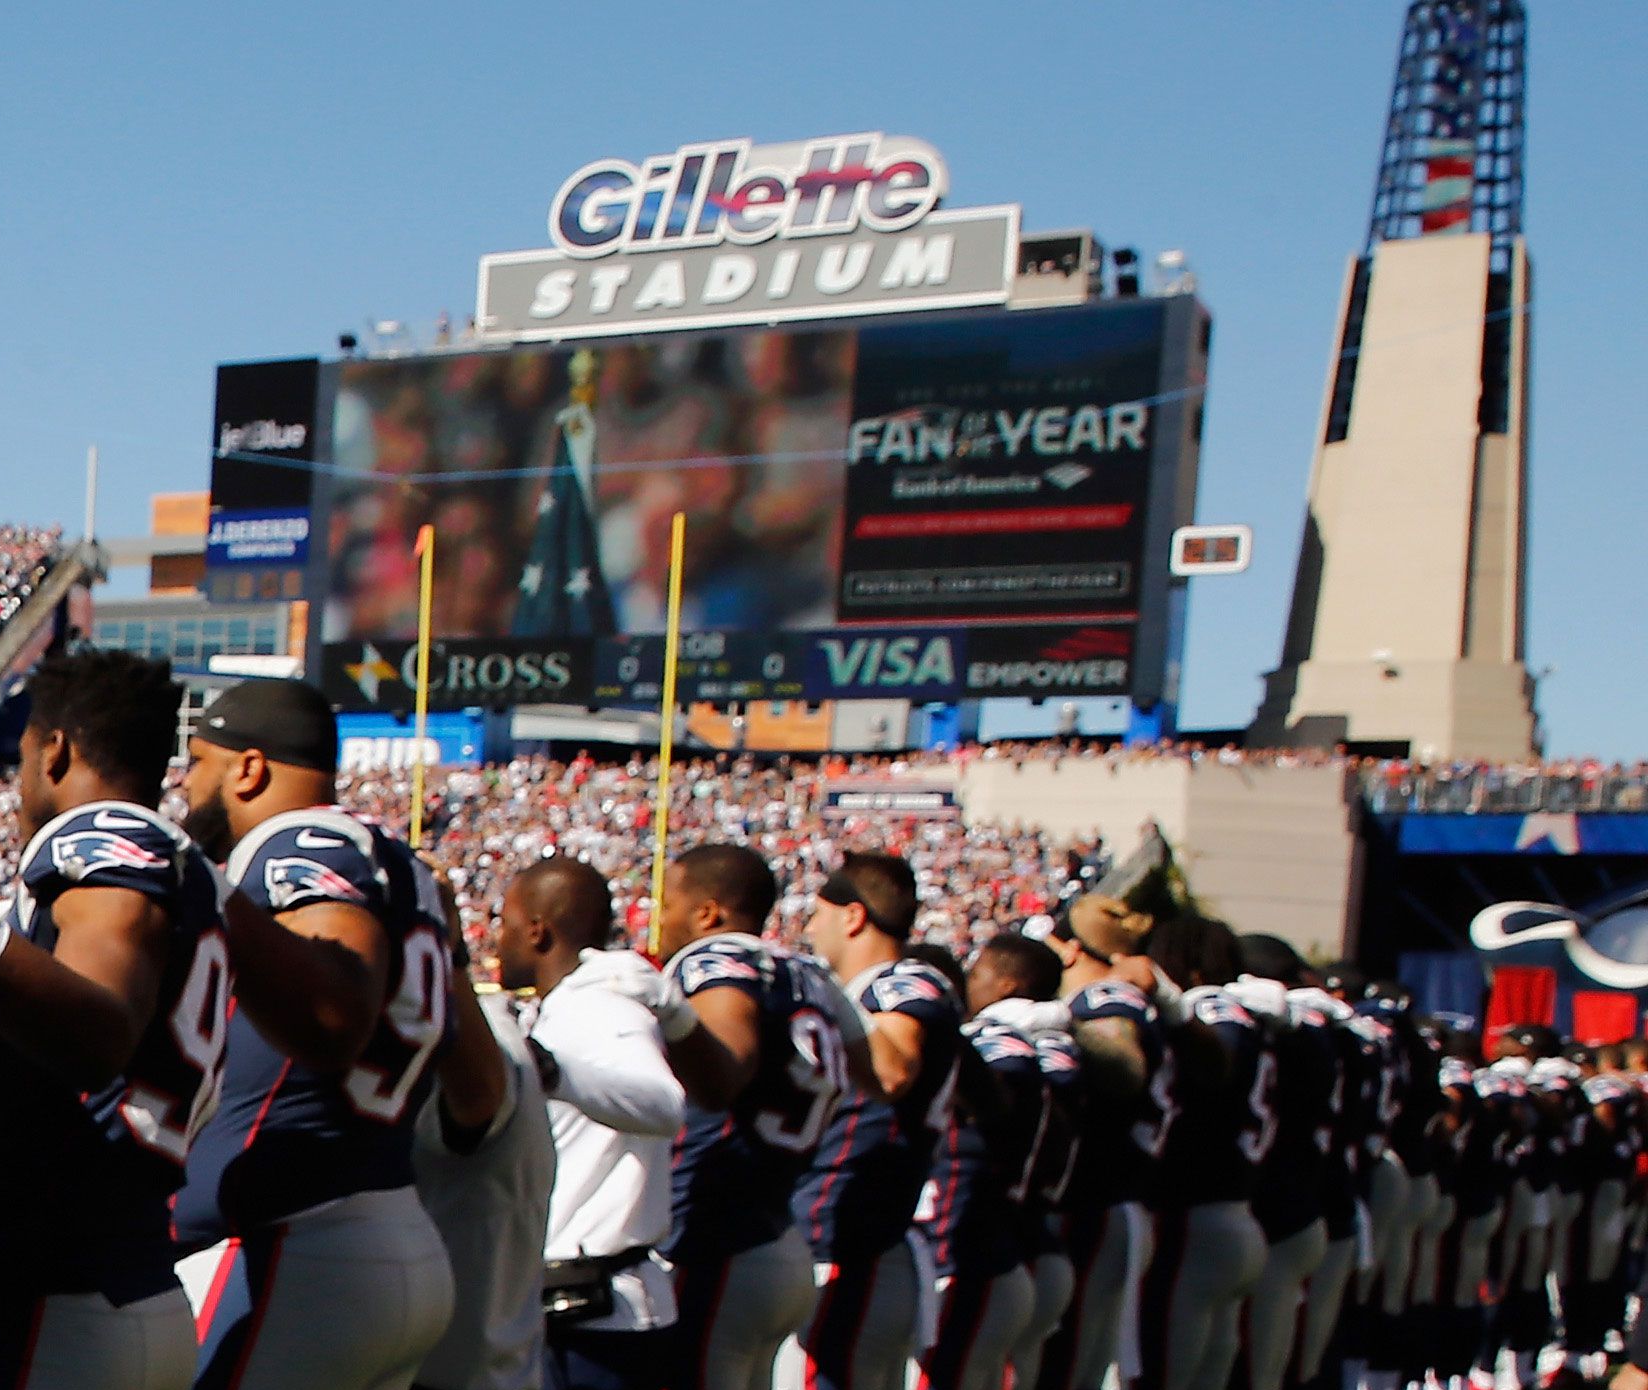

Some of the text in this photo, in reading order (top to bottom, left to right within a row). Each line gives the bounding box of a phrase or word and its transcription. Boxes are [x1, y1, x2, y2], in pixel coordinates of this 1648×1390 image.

[553, 138, 934, 254] Gillette
[528, 233, 955, 319] STADIUM
[847, 415, 953, 464] FAN
[994, 403, 1147, 456] YEAR
[401, 642, 572, 691] CROSS
[815, 636, 956, 687] VISA
[966, 659, 1128, 688] EMPOWER
